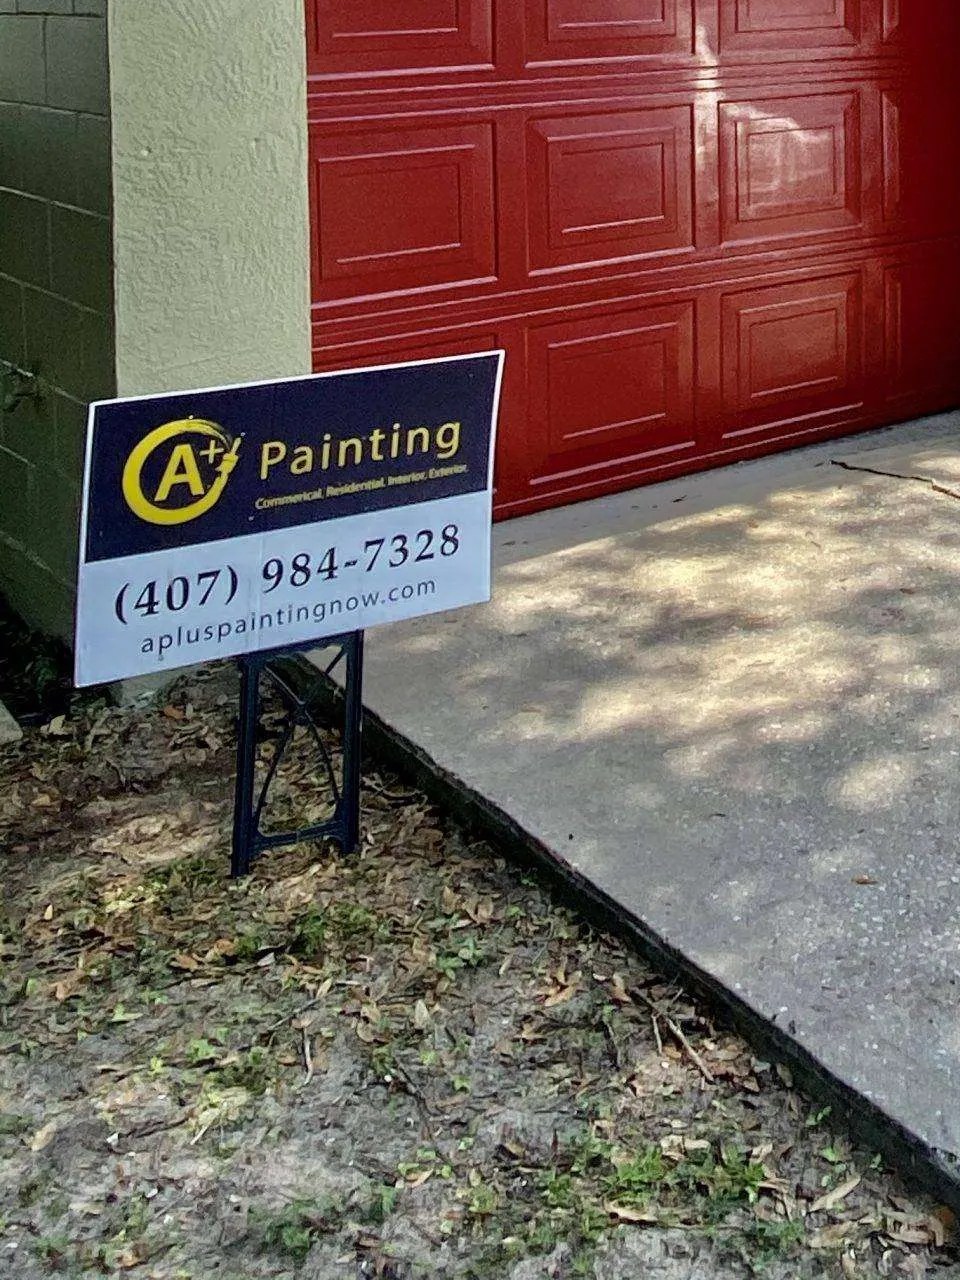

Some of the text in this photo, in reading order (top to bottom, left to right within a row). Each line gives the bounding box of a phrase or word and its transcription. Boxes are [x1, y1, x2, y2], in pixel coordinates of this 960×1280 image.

[260, 421, 461, 480] Painting
[114, 523, 461, 625] (407) 984-7328
[140, 579, 437, 651] apluspaintingnow.com
